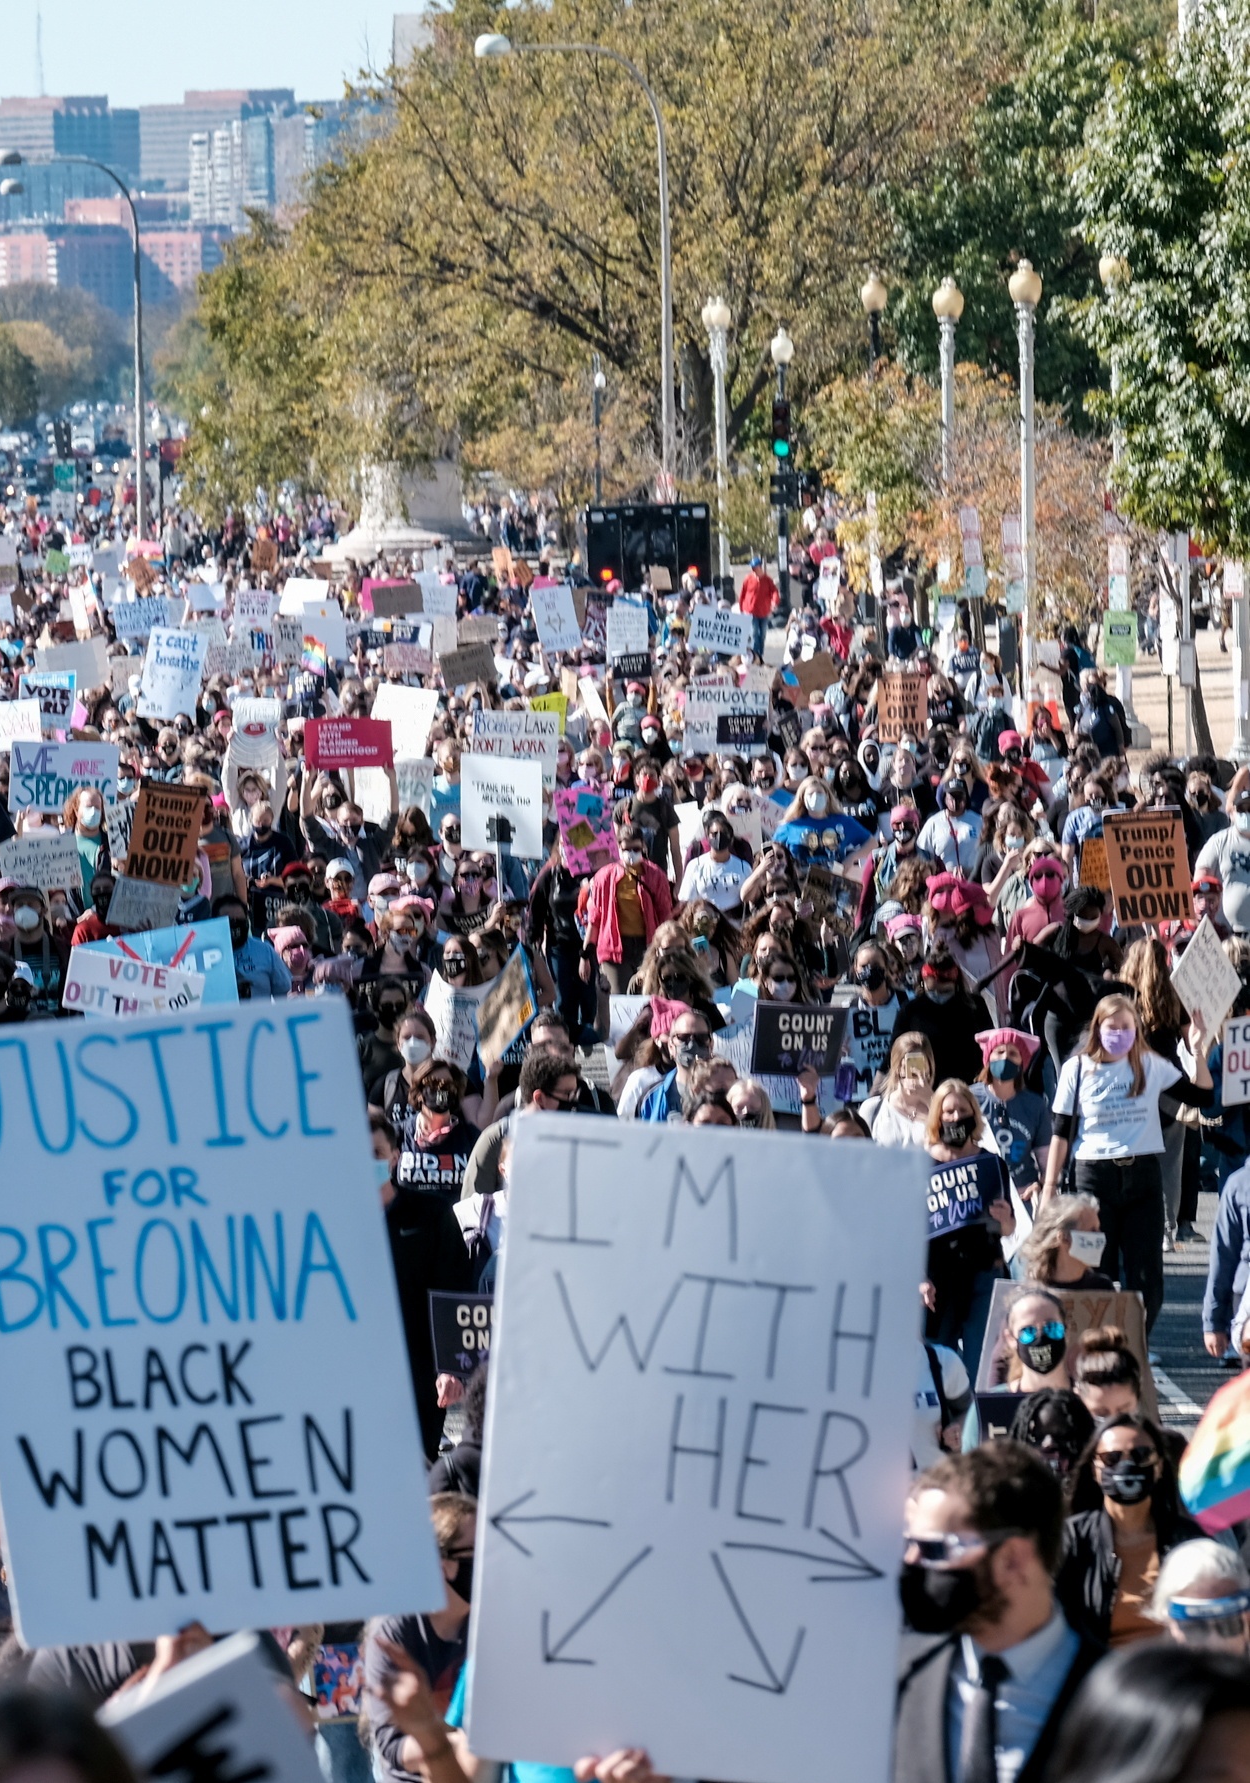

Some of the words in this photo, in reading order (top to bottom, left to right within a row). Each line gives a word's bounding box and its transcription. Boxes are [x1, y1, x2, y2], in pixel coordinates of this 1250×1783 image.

[697, 619, 742, 635] RUSHED
[715, 611, 730, 621] NO
[155, 635, 163, 645] I
[166, 634, 199, 652] can't
[693, 630, 741, 647] JUSTICE
[155, 654, 200, 672] breathe
[24, 684, 72, 700] VOTE
[886, 704, 917, 720] OUT
[524, 714, 556, 735] LAWS
[318, 746, 378, 756] PARENTHOOD
[512, 738, 546, 753] WORK
[14, 746, 59, 776] WE
[71, 758, 105, 776] ARE
[145, 792, 199, 814] Trump/
[144, 809, 192, 829] Pence
[142, 827, 188, 853] OUT
[1111, 823, 1176, 844] Trump/
[1119, 844, 1176, 862] Pence
[126, 852, 191, 883] NOW!
[1125, 863, 1175, 890] OUT
[1118, 890, 1190, 922] NOW!
[108, 957, 169, 989] VOTE
[65, 981, 109, 1008] OUT
[778, 1012, 834, 1034] COUNT
[781, 1033, 804, 1052] ON
[811, 1033, 829, 1051] US
[103, 1167, 210, 1208] FOR
[930, 1163, 979, 1193] OUNT
[529, 1133, 739, 1263] I'M
[926, 1191, 950, 1213] ON
[955, 1181, 980, 1203] US
[461, 1328, 490, 1351] ON
[554, 1269, 883, 1399] WITH
[65, 1340, 254, 1412] BLACK
[17, 1406, 357, 1511] WOMEN
[665, 1393, 873, 1538] HER
[84, 1503, 373, 1600] MATTER
